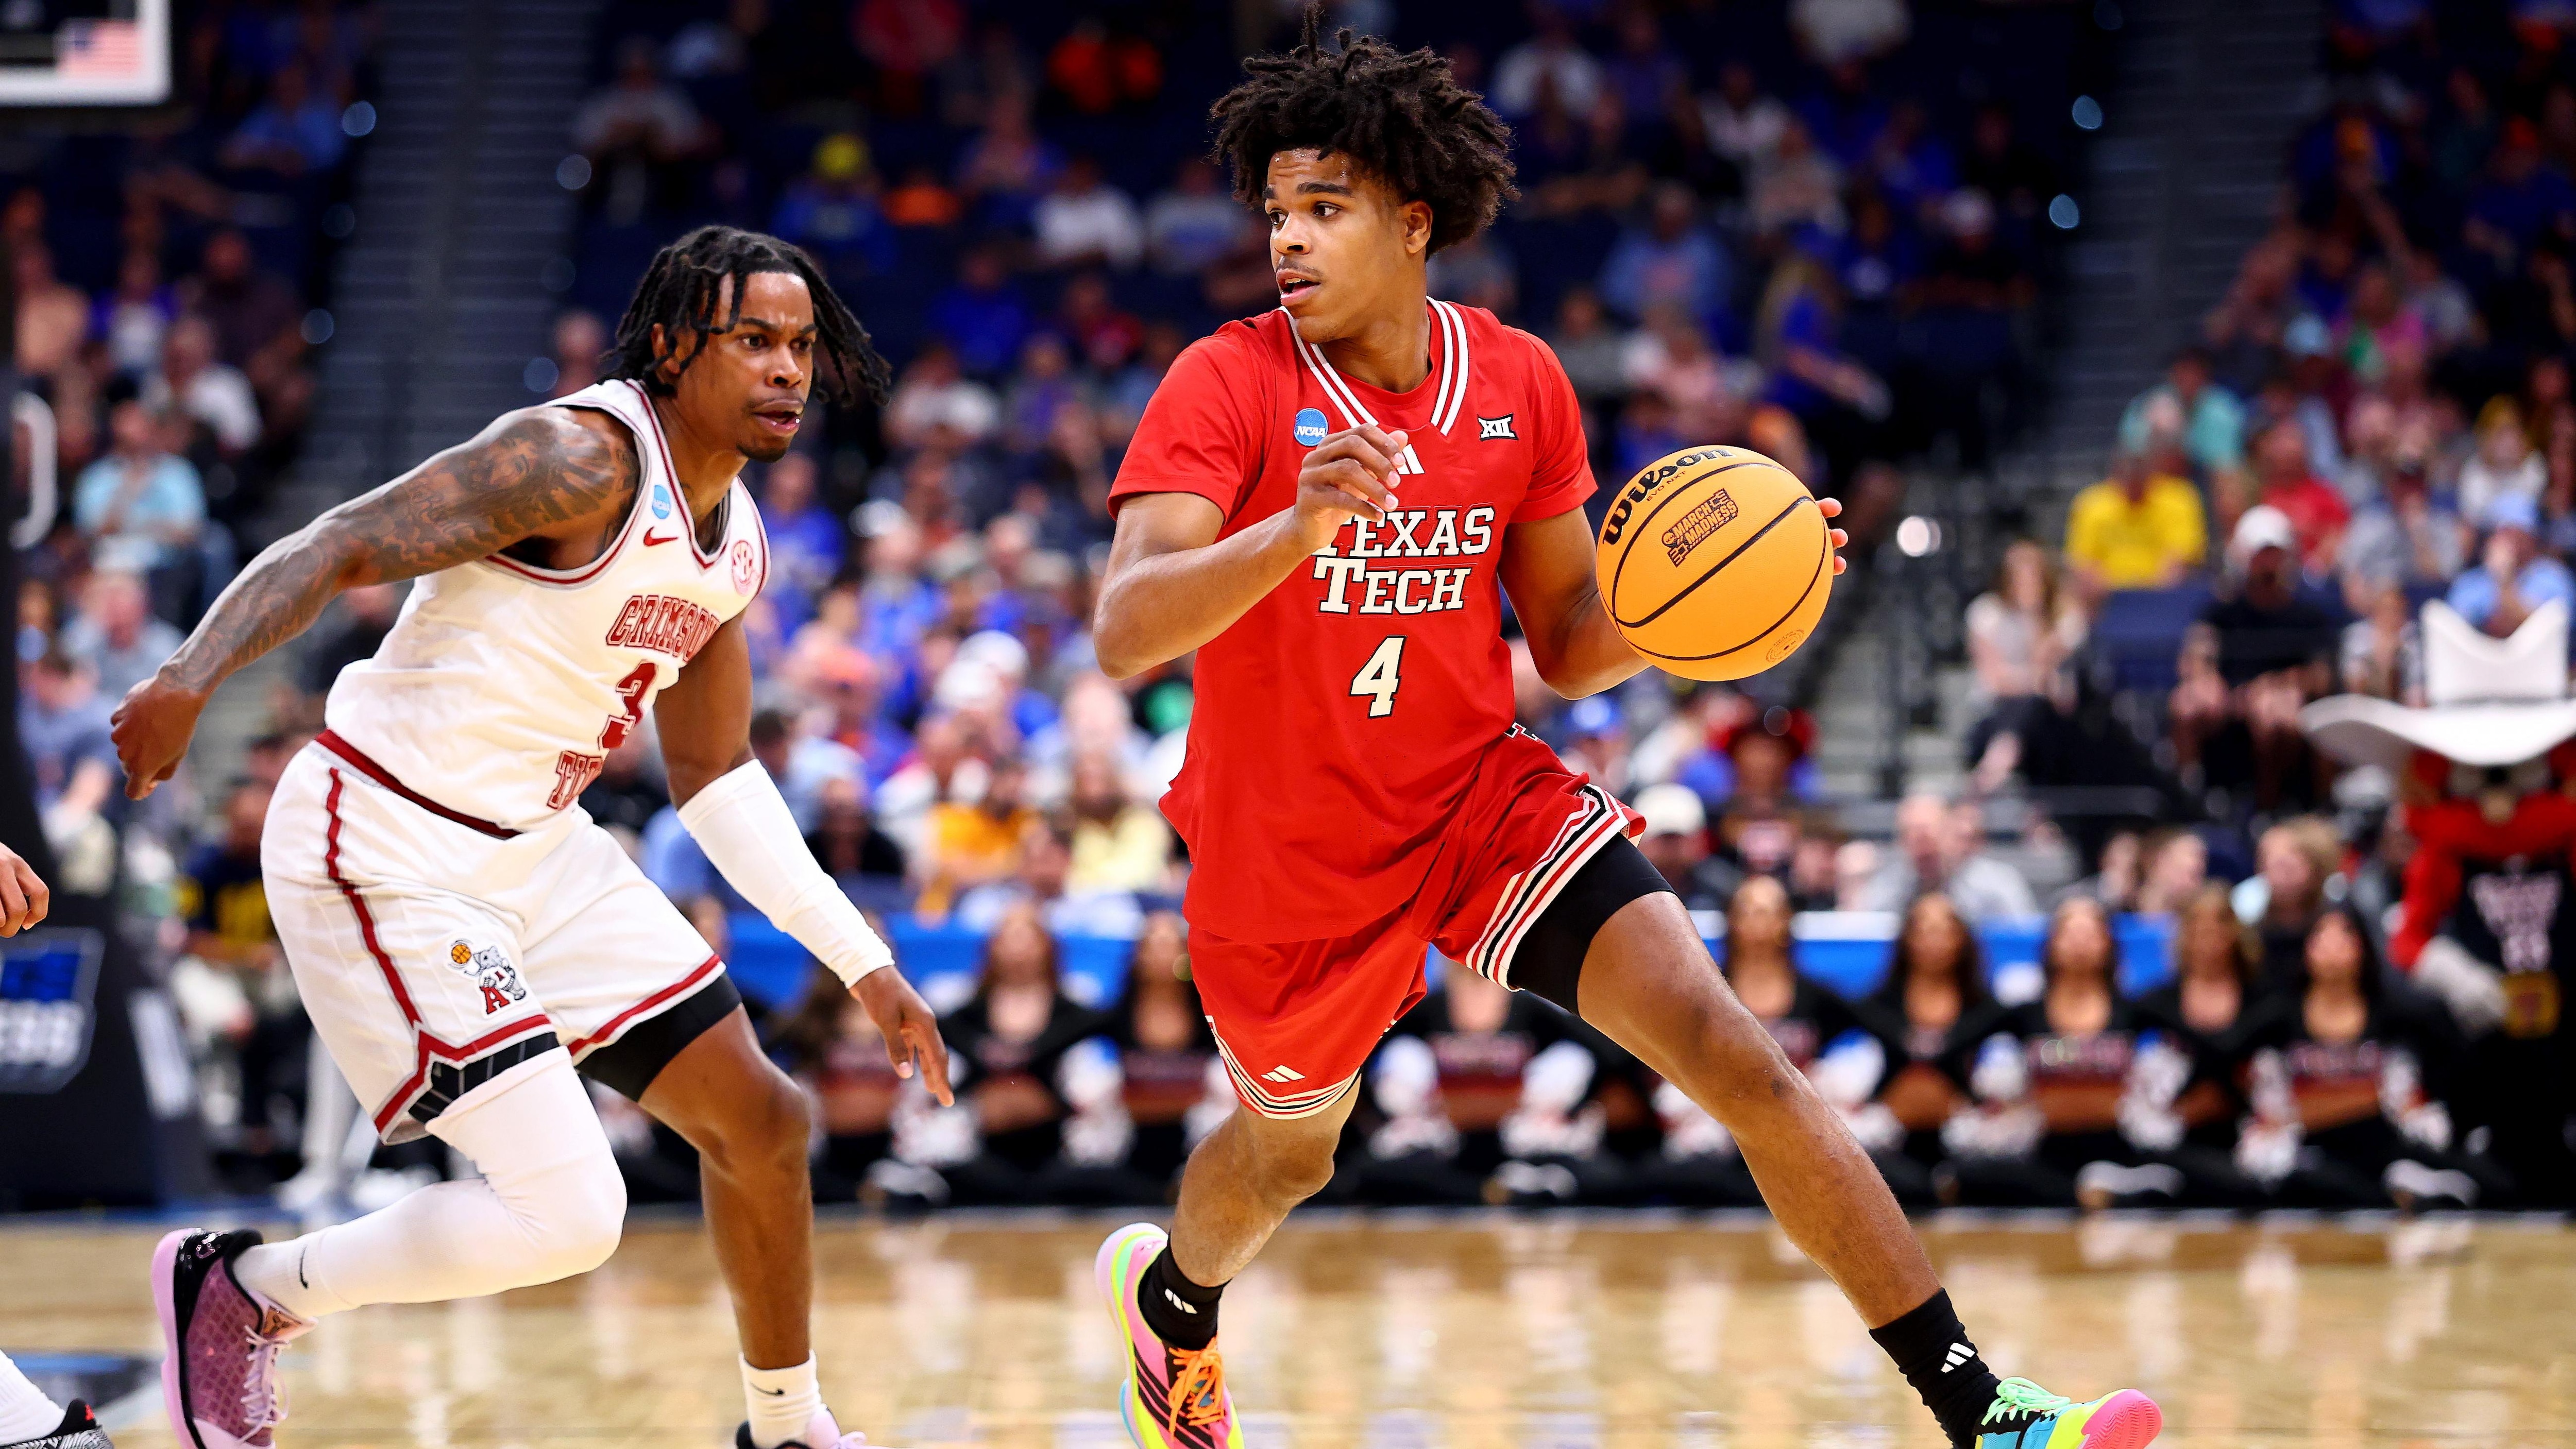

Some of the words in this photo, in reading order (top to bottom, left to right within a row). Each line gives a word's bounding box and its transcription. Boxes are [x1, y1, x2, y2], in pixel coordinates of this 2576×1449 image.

[1296, 425, 1326, 438] NCAA
[1647, 485, 1665, 502] EVO
[1667, 470, 1686, 484] NXT
[1312, 507, 1495, 557] EXAS
[1672, 502, 1713, 539] MARCH
[1684, 500, 1737, 545] MADNESS
[1312, 555, 1471, 615] TECH
[1349, 635, 1406, 718] 4
[597, 659, 658, 751] 3
[479, 985, 510, 1015] A
